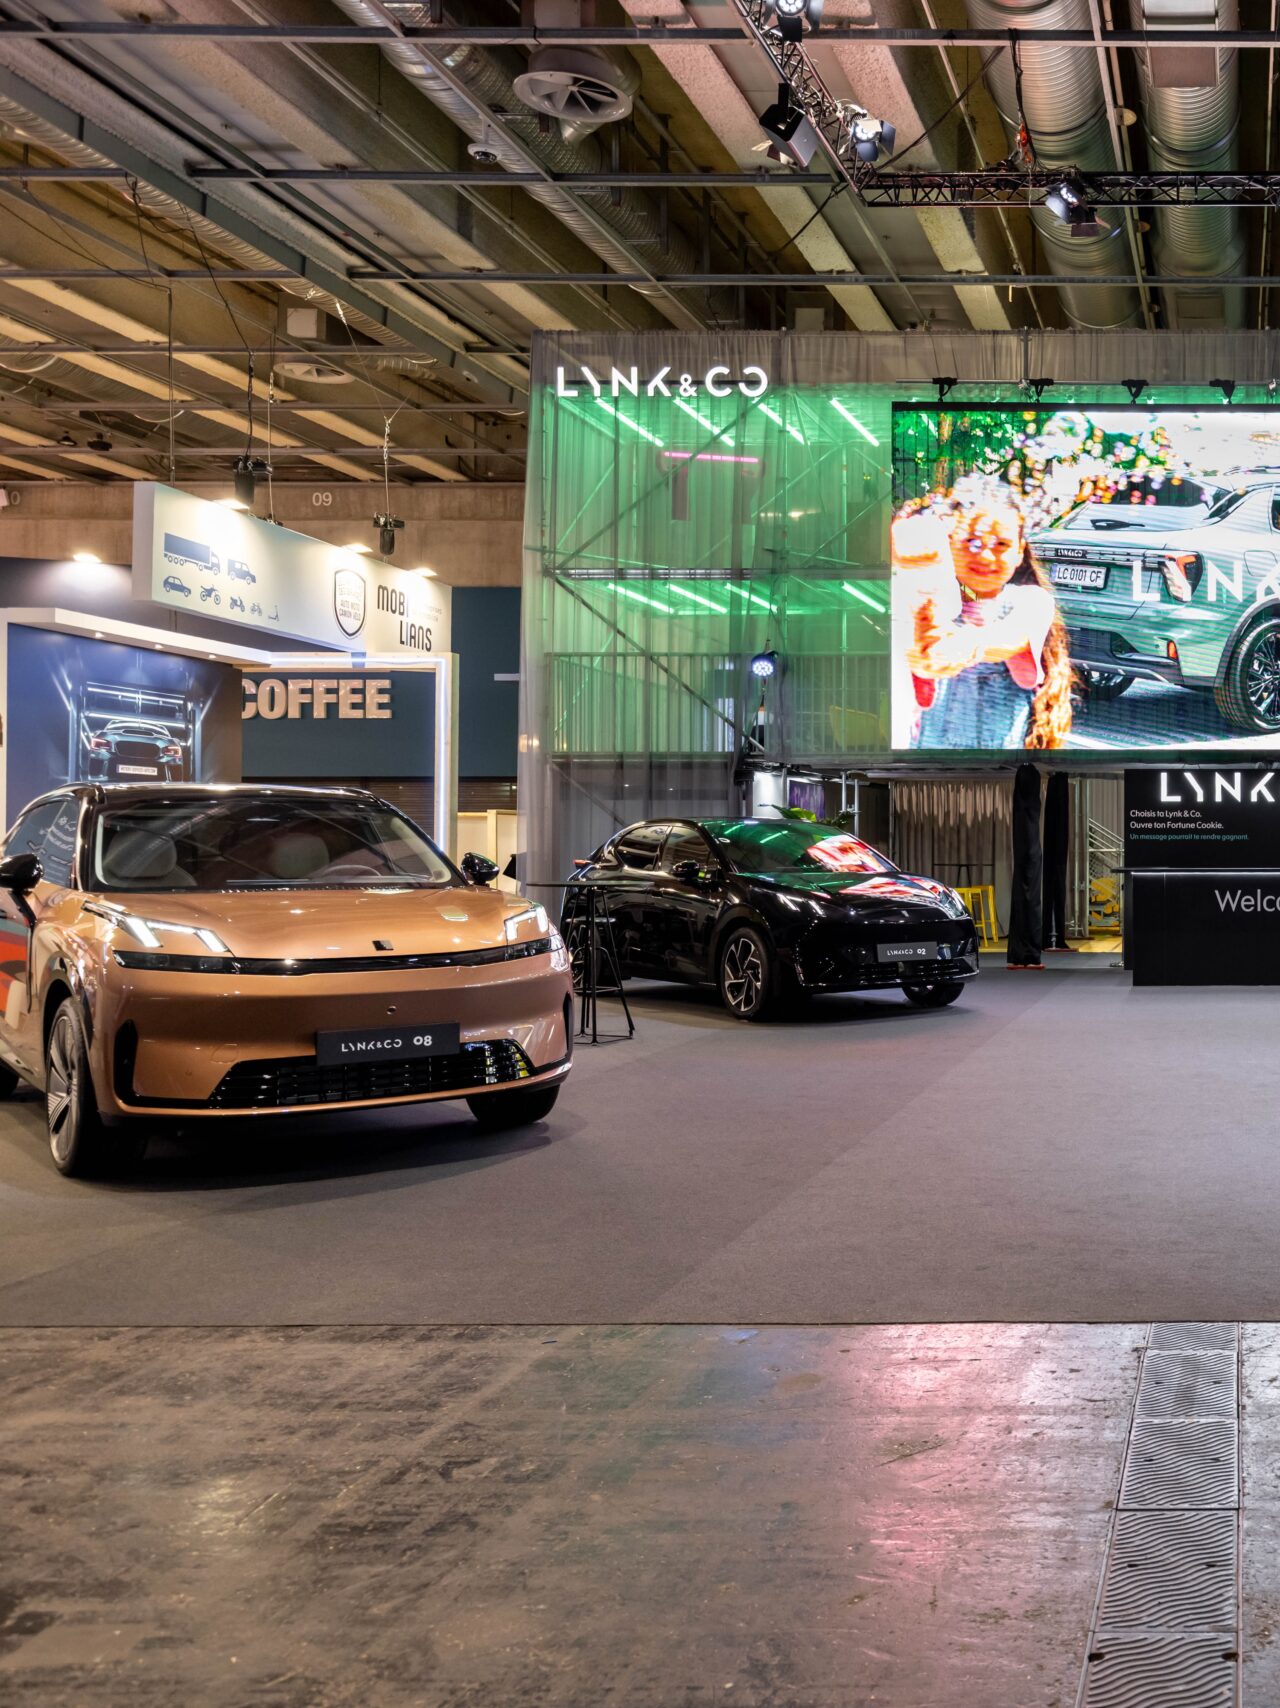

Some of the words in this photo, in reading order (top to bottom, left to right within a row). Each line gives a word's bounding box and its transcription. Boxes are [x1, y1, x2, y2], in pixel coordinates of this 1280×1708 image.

[557, 366, 769, 397] LYNK&CO
[312, 492, 332, 506] 09
[1057, 567, 1068, 580] LC
[1070, 568, 1087, 581] 0101
[1090, 570, 1102, 582] CF
[399, 620, 432, 652] LIANS
[241, 678, 393, 720] COFFEE
[1130, 810, 1156, 818] Choisis
[1165, 810, 1182, 818] Lynk
[1130, 821, 1152, 829] Ouvre
[1154, 821, 1165, 829] ton
[1167, 821, 1195, 829] Fortune
[1196, 821, 1224, 829] Cookie.
[1139, 834, 1167, 842] message
[341, 1038, 403, 1052] LYNK&CO
[413, 1035, 432, 1046] 08
